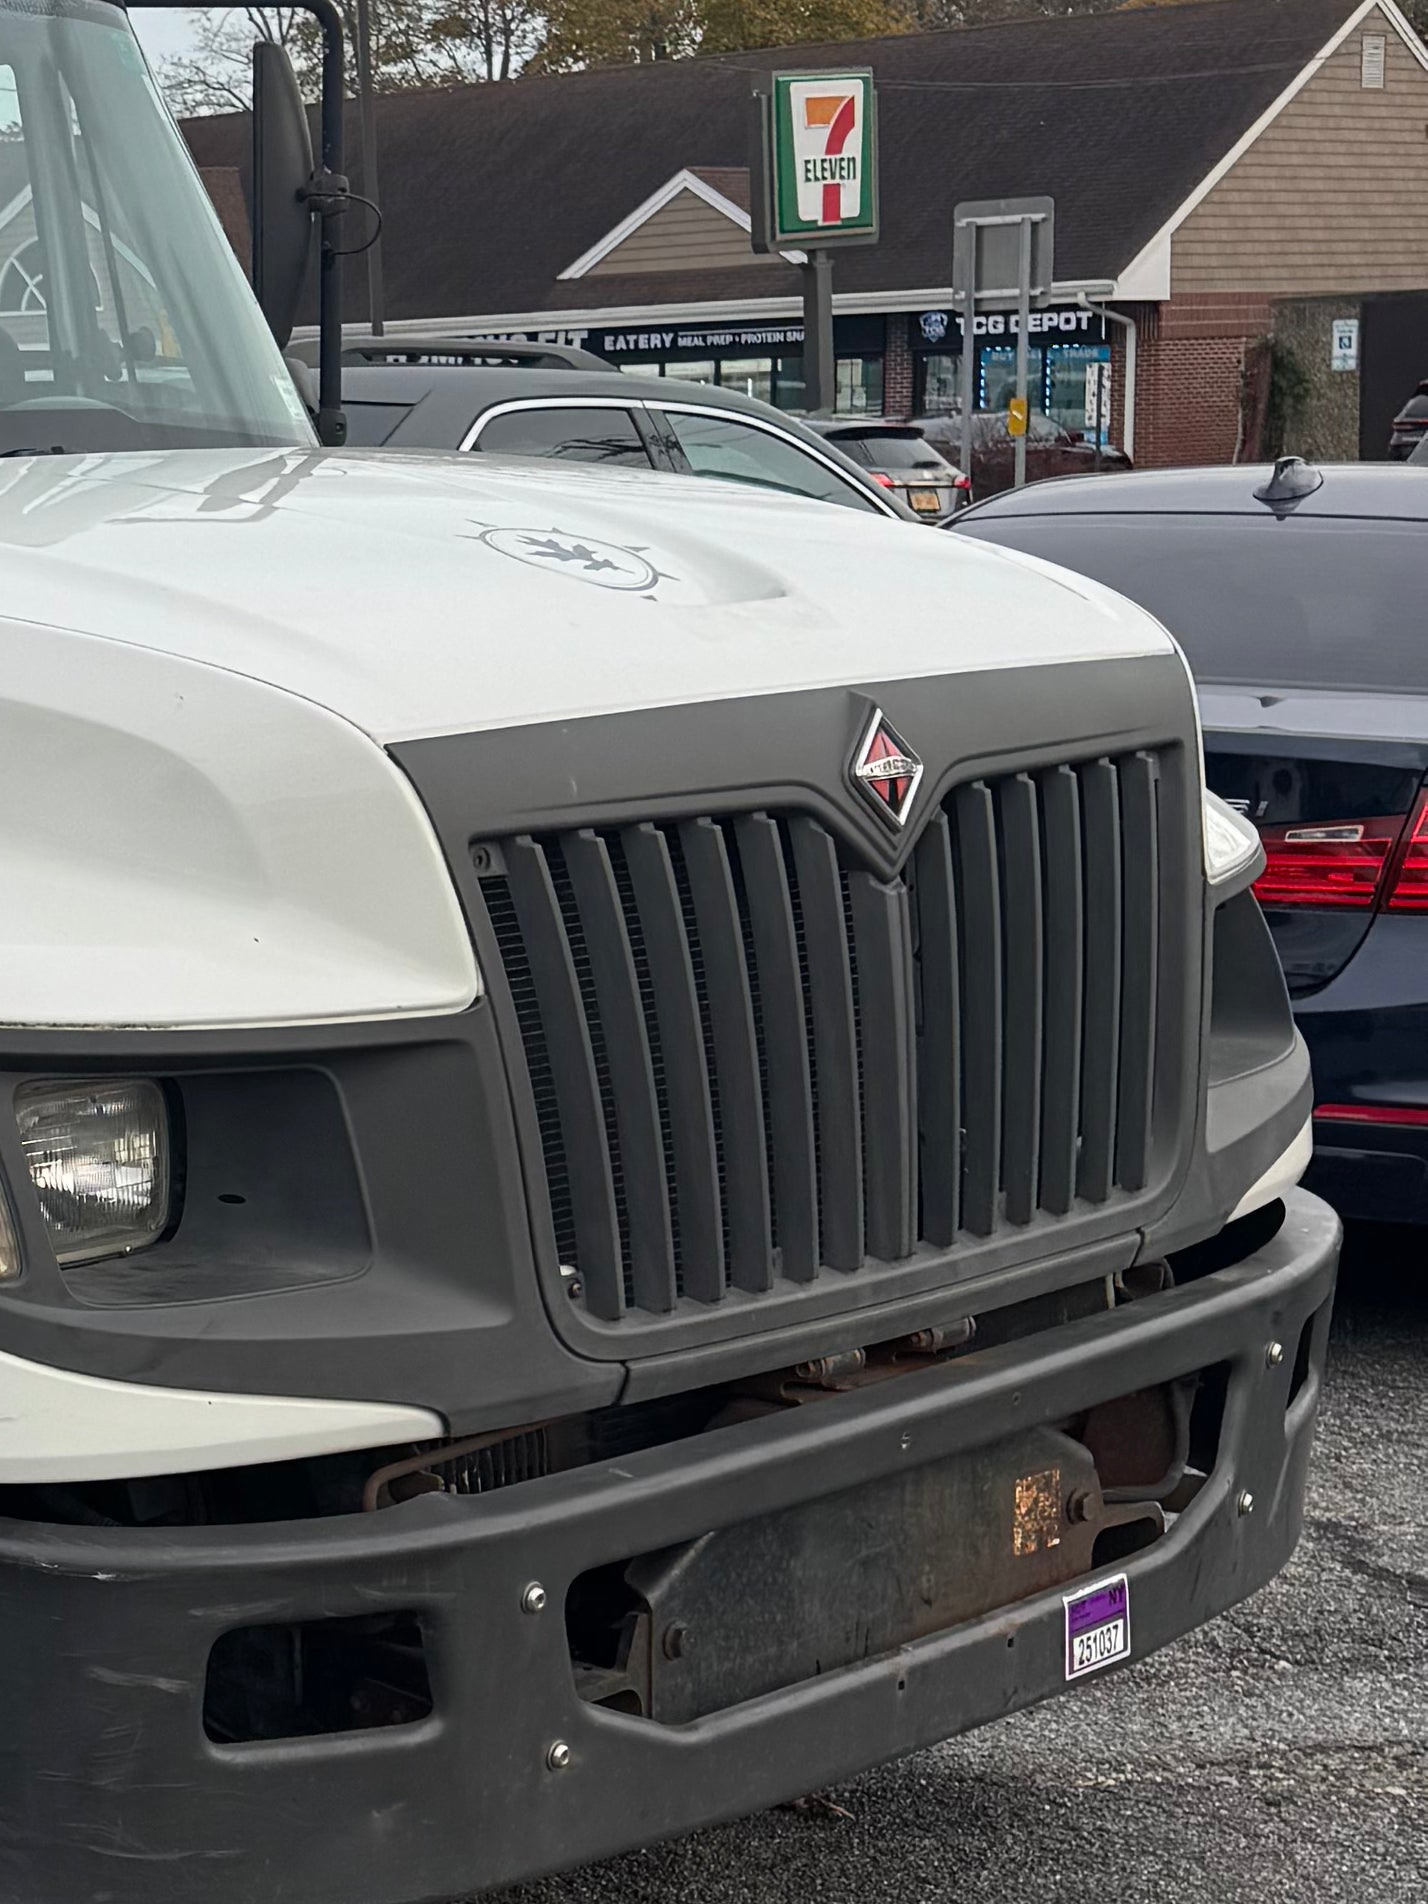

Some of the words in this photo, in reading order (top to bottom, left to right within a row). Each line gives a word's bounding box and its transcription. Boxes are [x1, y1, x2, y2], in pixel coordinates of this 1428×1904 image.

[805, 96, 855, 223] 7
[604, 333, 674, 351] EATERY
[677, 336, 705, 347] MEAL
[707, 334, 732, 346] PREP
[741, 331, 785, 344] PROTEIN
[1108, 1583, 1125, 1607] NY
[1078, 1624, 1119, 1666] 251037
